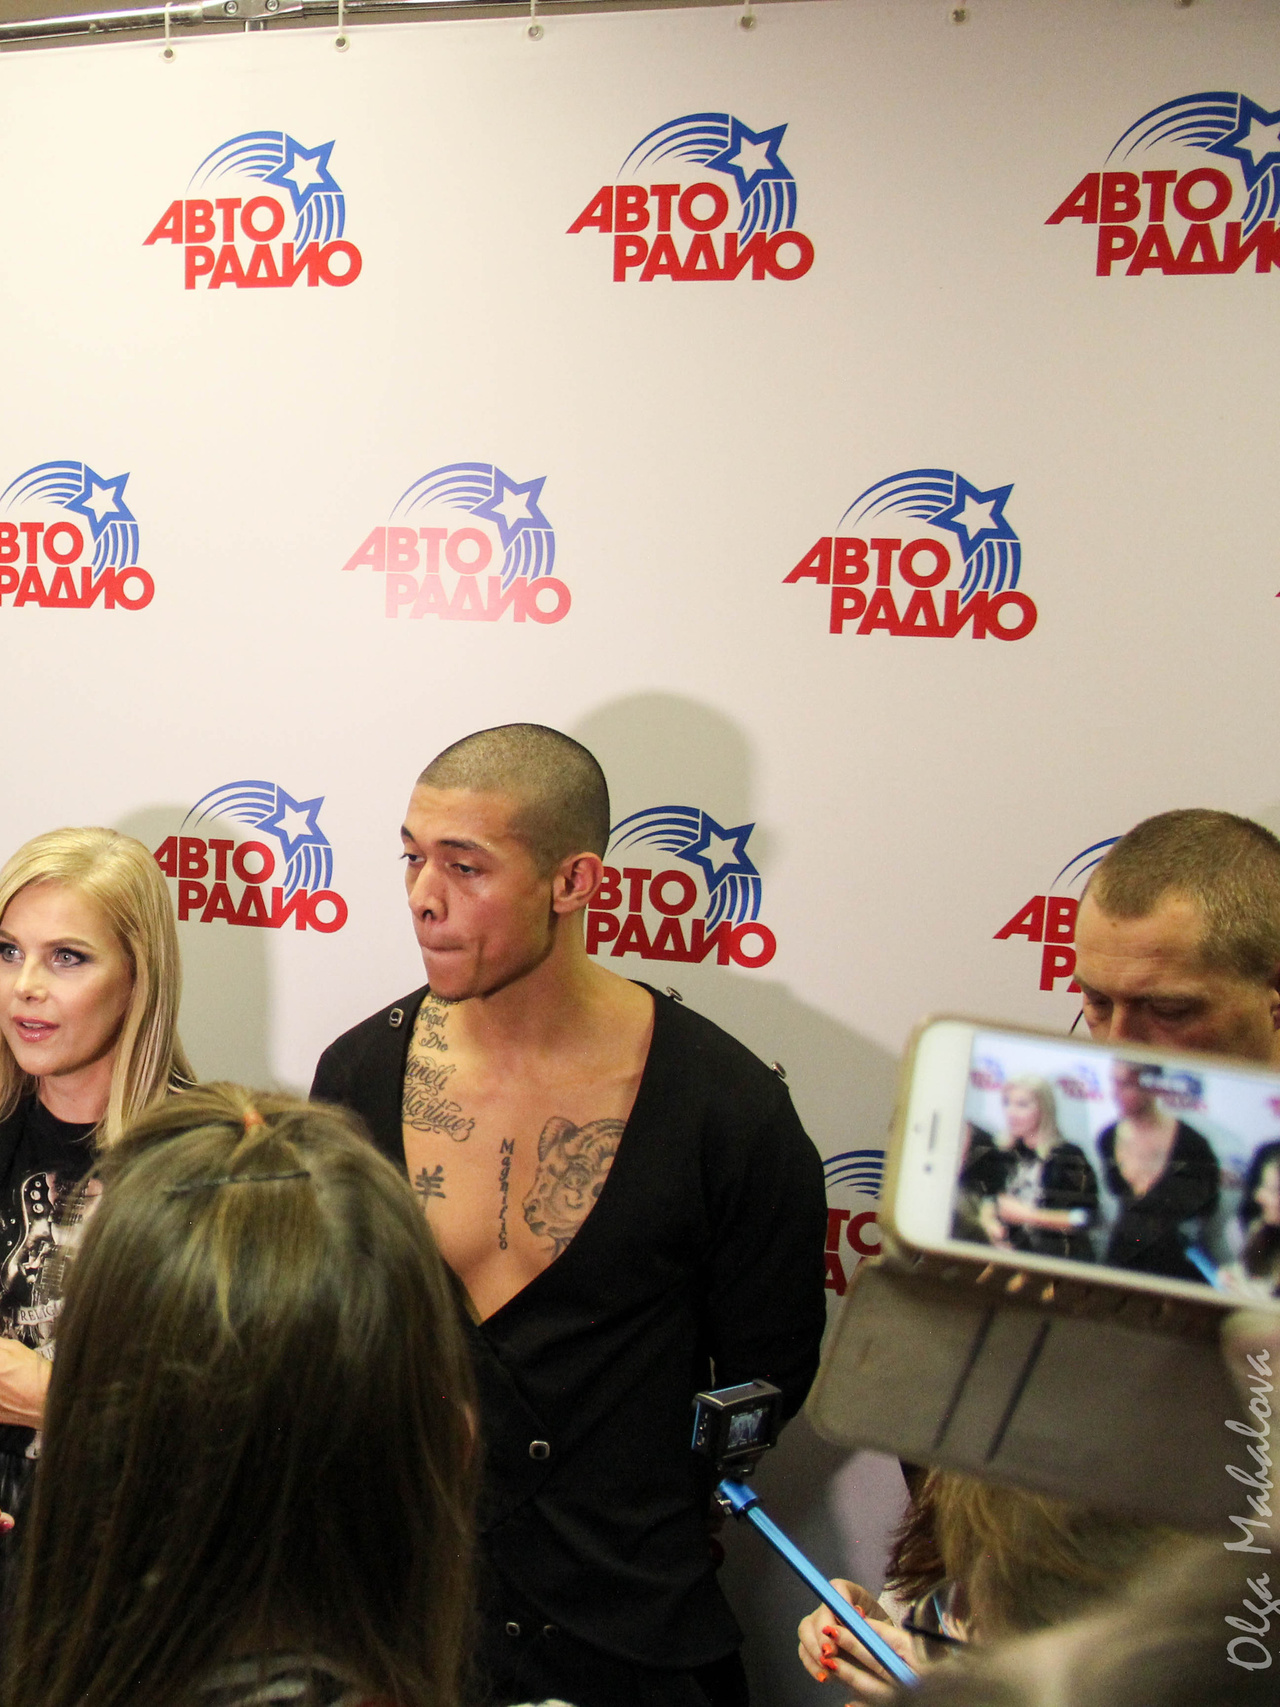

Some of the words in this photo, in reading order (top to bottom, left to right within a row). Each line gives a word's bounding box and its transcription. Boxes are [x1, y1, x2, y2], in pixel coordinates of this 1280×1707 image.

[143, 195, 285, 246] АВТО
[566, 181, 729, 235] АВТО
[1044, 167, 1232, 225] АВТО
[185, 239, 363, 291] РАДИО
[613, 230, 815, 283] РАДИО
[1096, 220, 1280, 277] РАДИ
[341, 526, 493, 575] АВТО
[783, 536, 951, 589] АВТО
[384, 573, 572, 625] РАДИО
[828, 585, 1038, 642] РАДИО
[152, 835, 276, 885] АВТО
[177, 879, 349, 934] РАДИО
[587, 865, 698, 917] ВТО
[585, 910, 777, 969] РАДИО
[992, 894, 1080, 944] АВ
[824, 1207, 882, 1257] ТО
